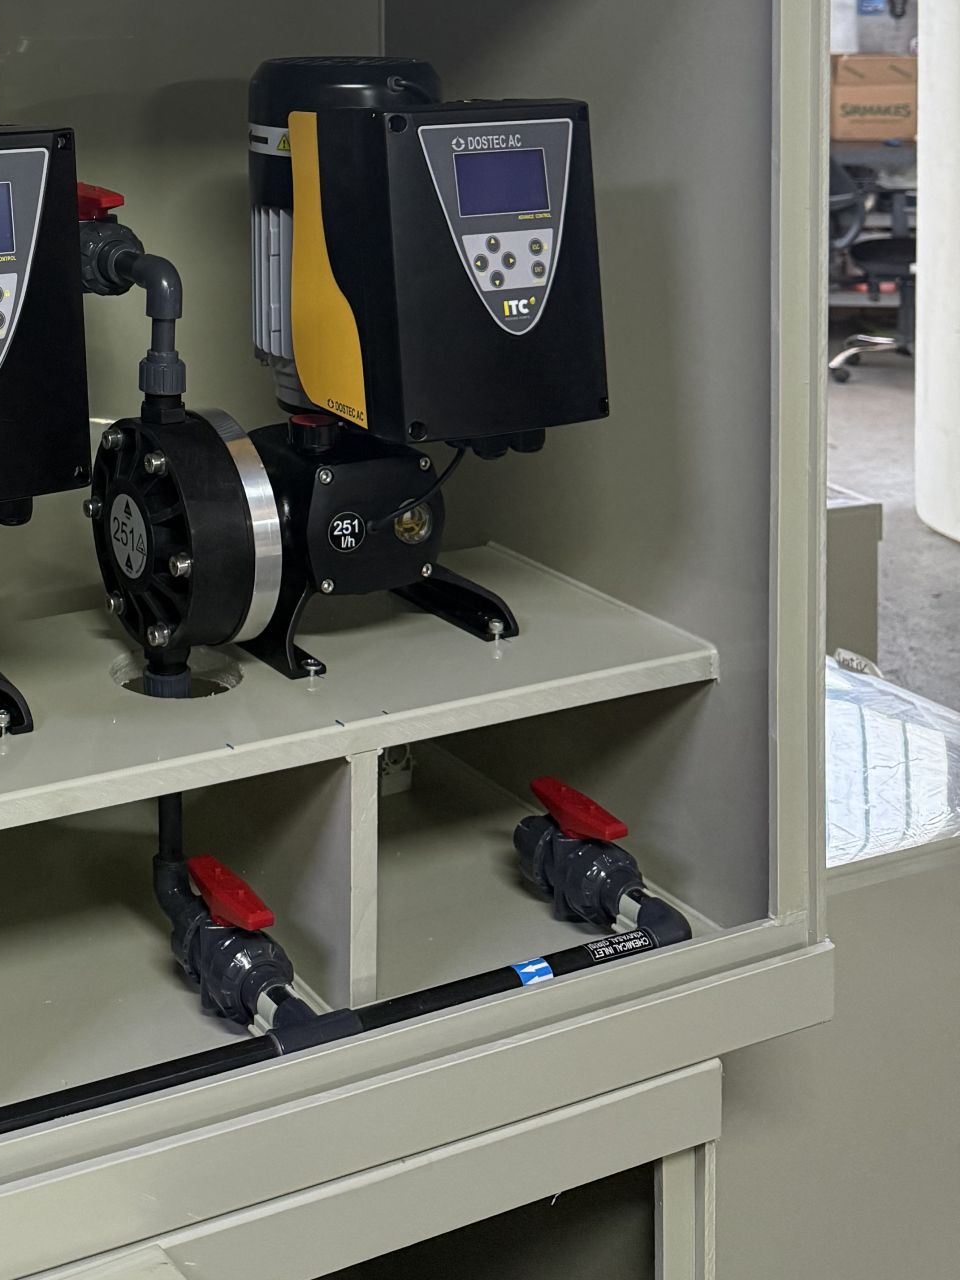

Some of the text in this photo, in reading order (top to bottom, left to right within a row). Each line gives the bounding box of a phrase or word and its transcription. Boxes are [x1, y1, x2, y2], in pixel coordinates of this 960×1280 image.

[467, 133, 522, 150] DOSTEC AC
[503, 298, 530, 317] ITC
[335, 401, 364, 422] DOSTEC AC
[112, 516, 135, 552] 251
[333, 518, 359, 536] 251
[341, 536, 356, 549] l/h
[594, 937, 649, 959] CHEMICAL INLET
